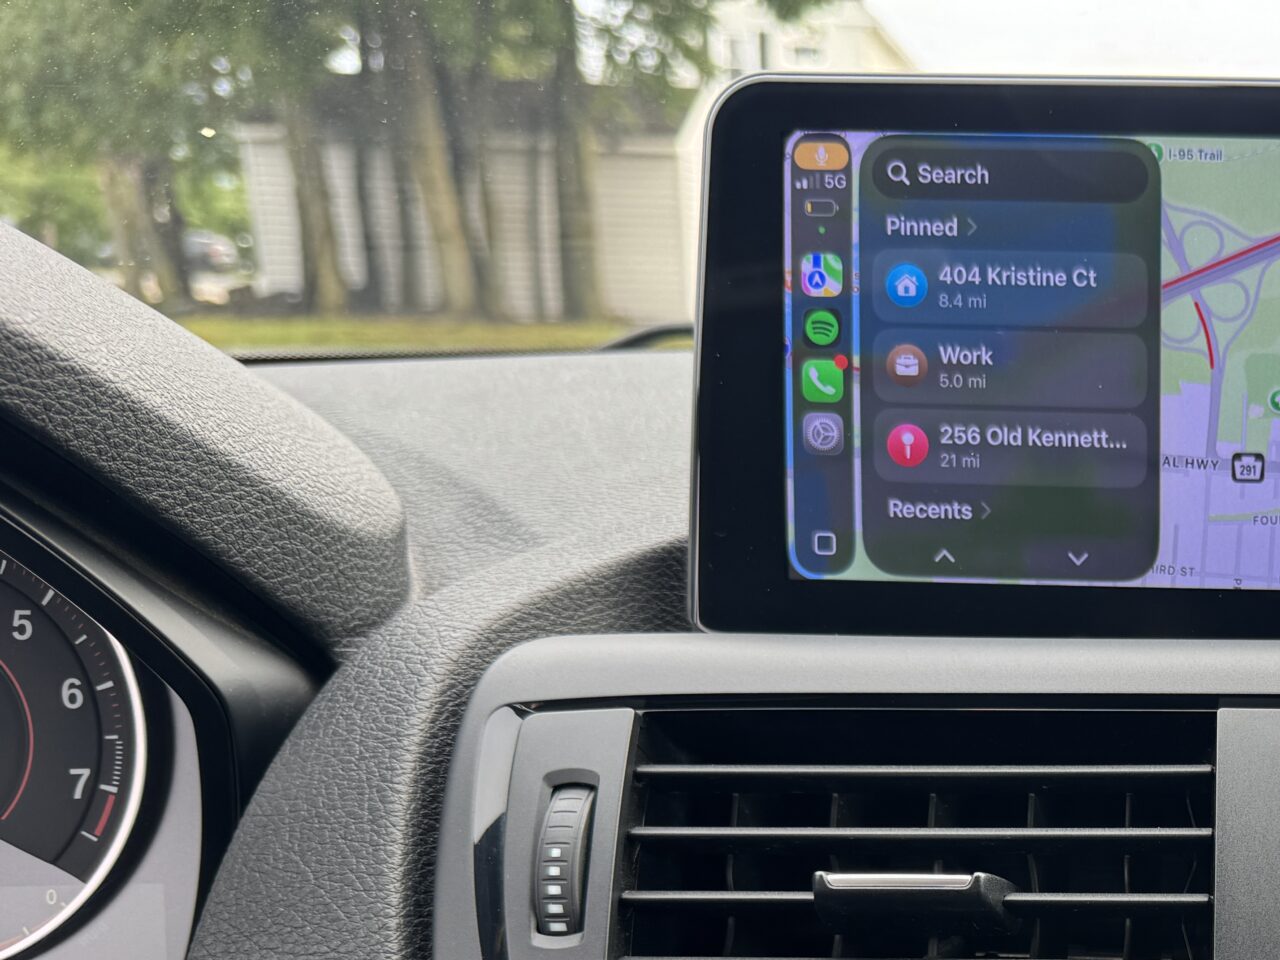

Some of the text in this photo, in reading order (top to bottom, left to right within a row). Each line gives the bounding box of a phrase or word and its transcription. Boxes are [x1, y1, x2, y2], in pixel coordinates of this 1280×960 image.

[1168, 149, 1223, 162] I-95 Trail
[824, 174, 847, 189] 5G
[918, 163, 989, 185] Search
[886, 216, 958, 238] Pinned
[939, 265, 1097, 288] 404 Kristine Ct
[939, 294, 987, 309] 8.4 mi
[939, 346, 993, 366] Work
[939, 374, 987, 389] 5.0 mi
[940, 425, 1127, 449] 256 Old Kennett...
[940, 454, 980, 469] 21 mi
[1162, 456, 1219, 470] AL HWY
[1240, 465, 1256, 476] 291
[889, 500, 973, 520] Recents
[1180, 566, 1195, 577] ST
[12, 610, 33, 641] 5
[61, 678, 84, 709] 6
[69, 768, 91, 800] 7
[46, 889, 57, 905] 0
